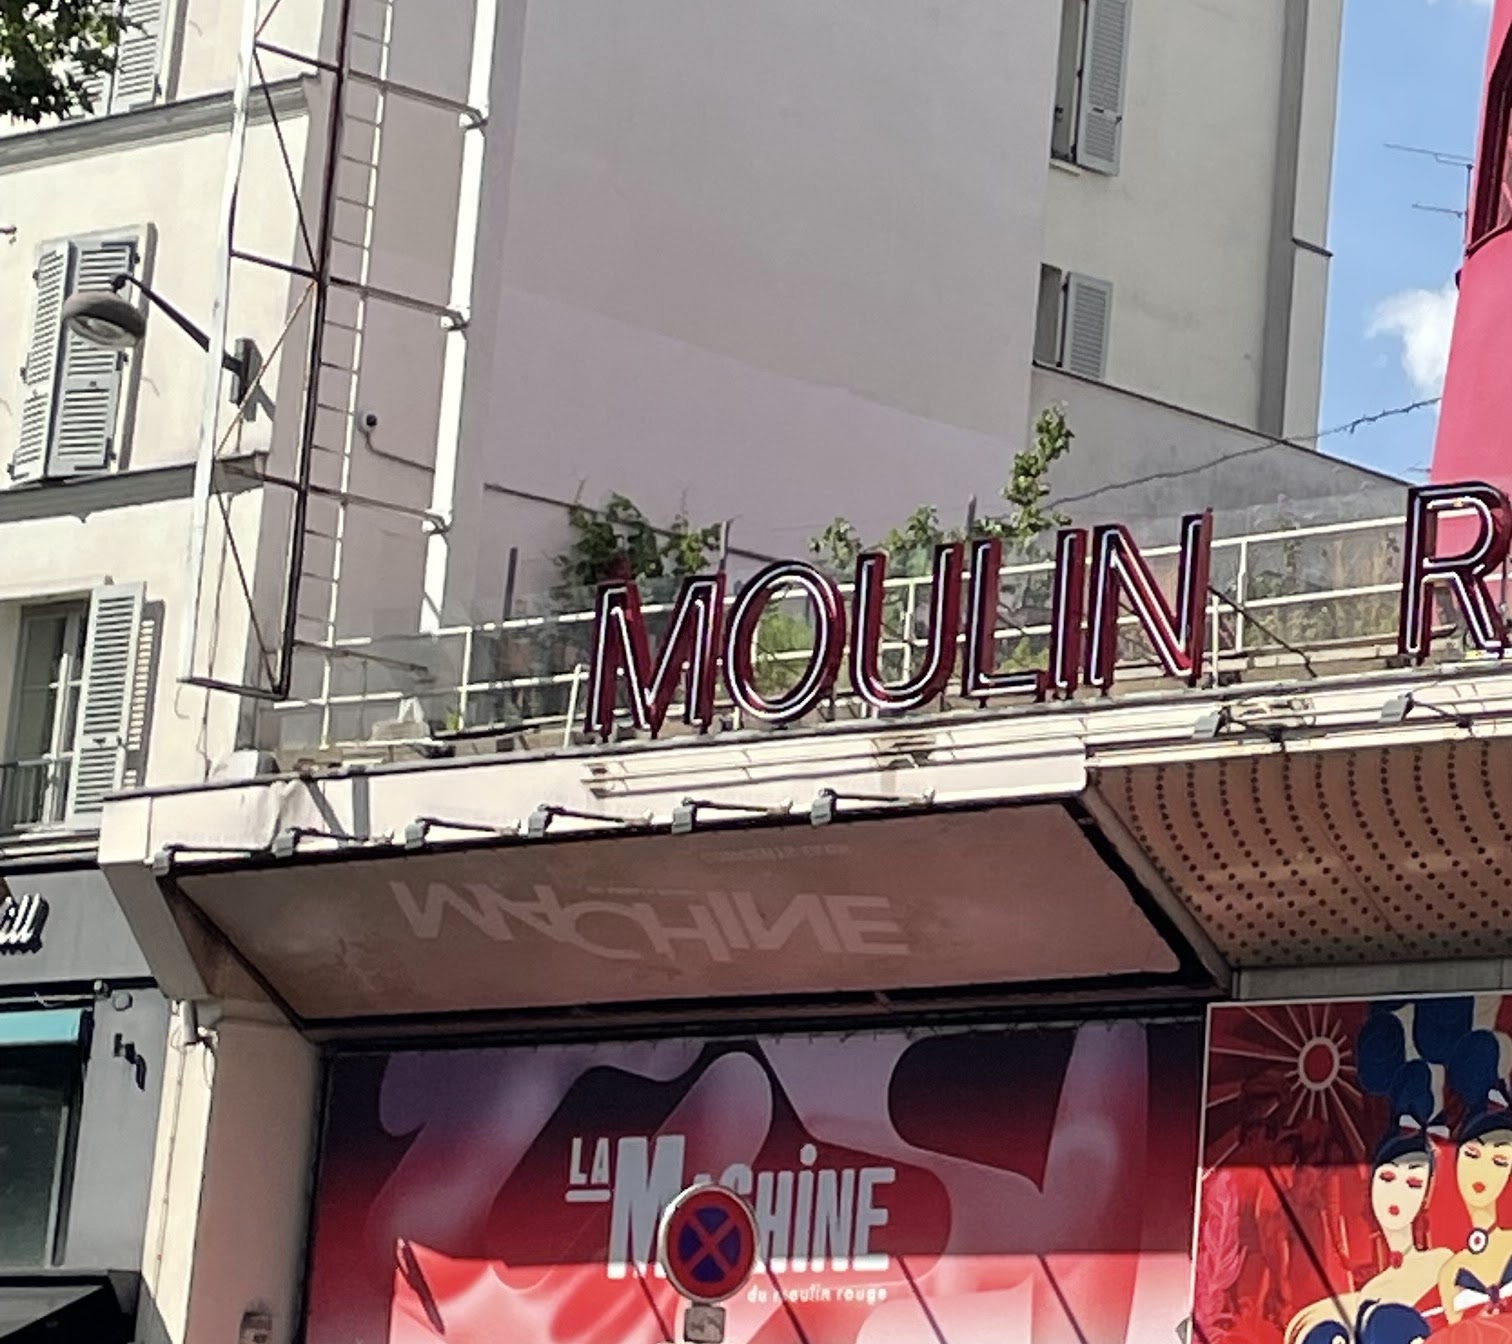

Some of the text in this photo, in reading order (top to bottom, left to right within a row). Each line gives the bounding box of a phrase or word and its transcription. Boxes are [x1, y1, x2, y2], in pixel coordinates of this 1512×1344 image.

[585, 508, 1213, 736] MOULIN
[569, 1136, 610, 1185] LA
[747, 1284, 767, 1303] du
[836, 1288, 887, 1306] rouge
